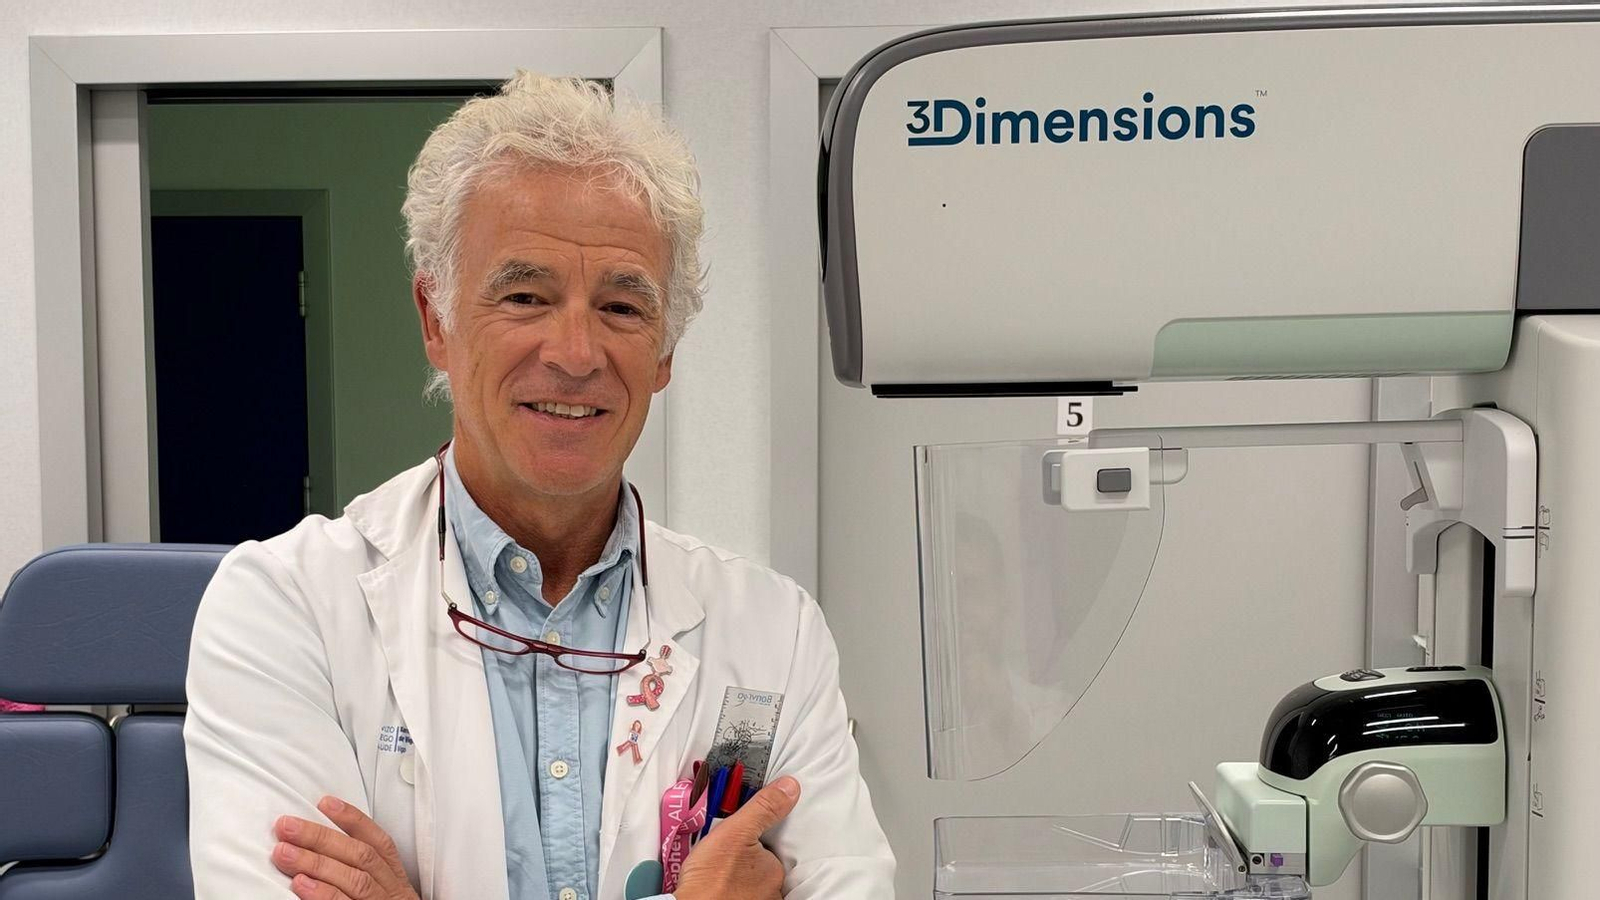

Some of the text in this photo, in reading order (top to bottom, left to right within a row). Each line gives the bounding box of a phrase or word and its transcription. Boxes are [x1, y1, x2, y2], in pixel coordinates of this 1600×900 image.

[906, 92, 1256, 146] 3Dimensions
[1066, 401, 1083, 427] 5
[380, 734, 394, 743] EGO
